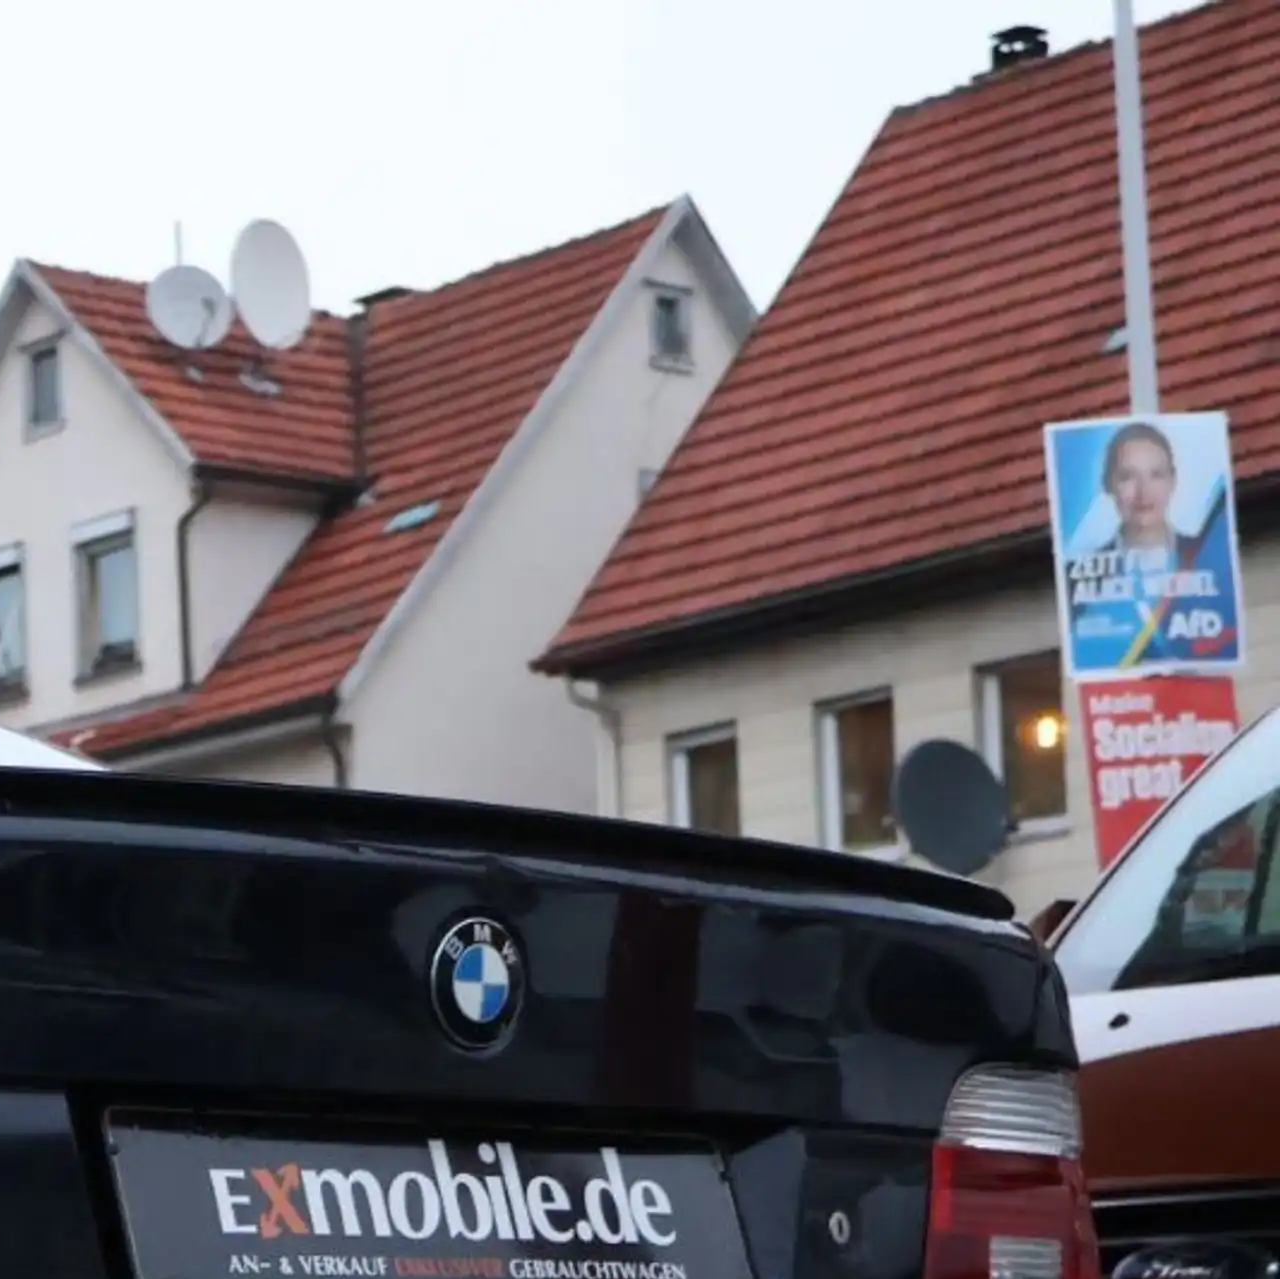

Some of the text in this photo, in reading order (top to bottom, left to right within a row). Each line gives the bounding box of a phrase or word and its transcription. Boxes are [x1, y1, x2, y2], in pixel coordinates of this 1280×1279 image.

[1168, 609, 1223, 640] AfD
[444, 923, 518, 964] BMW
[208, 1138, 677, 1246] EXmobile.de
[229, 1254, 271, 1274] AN-
[279, 1256, 294, 1275] &
[297, 1255, 388, 1277] VERKAUF
